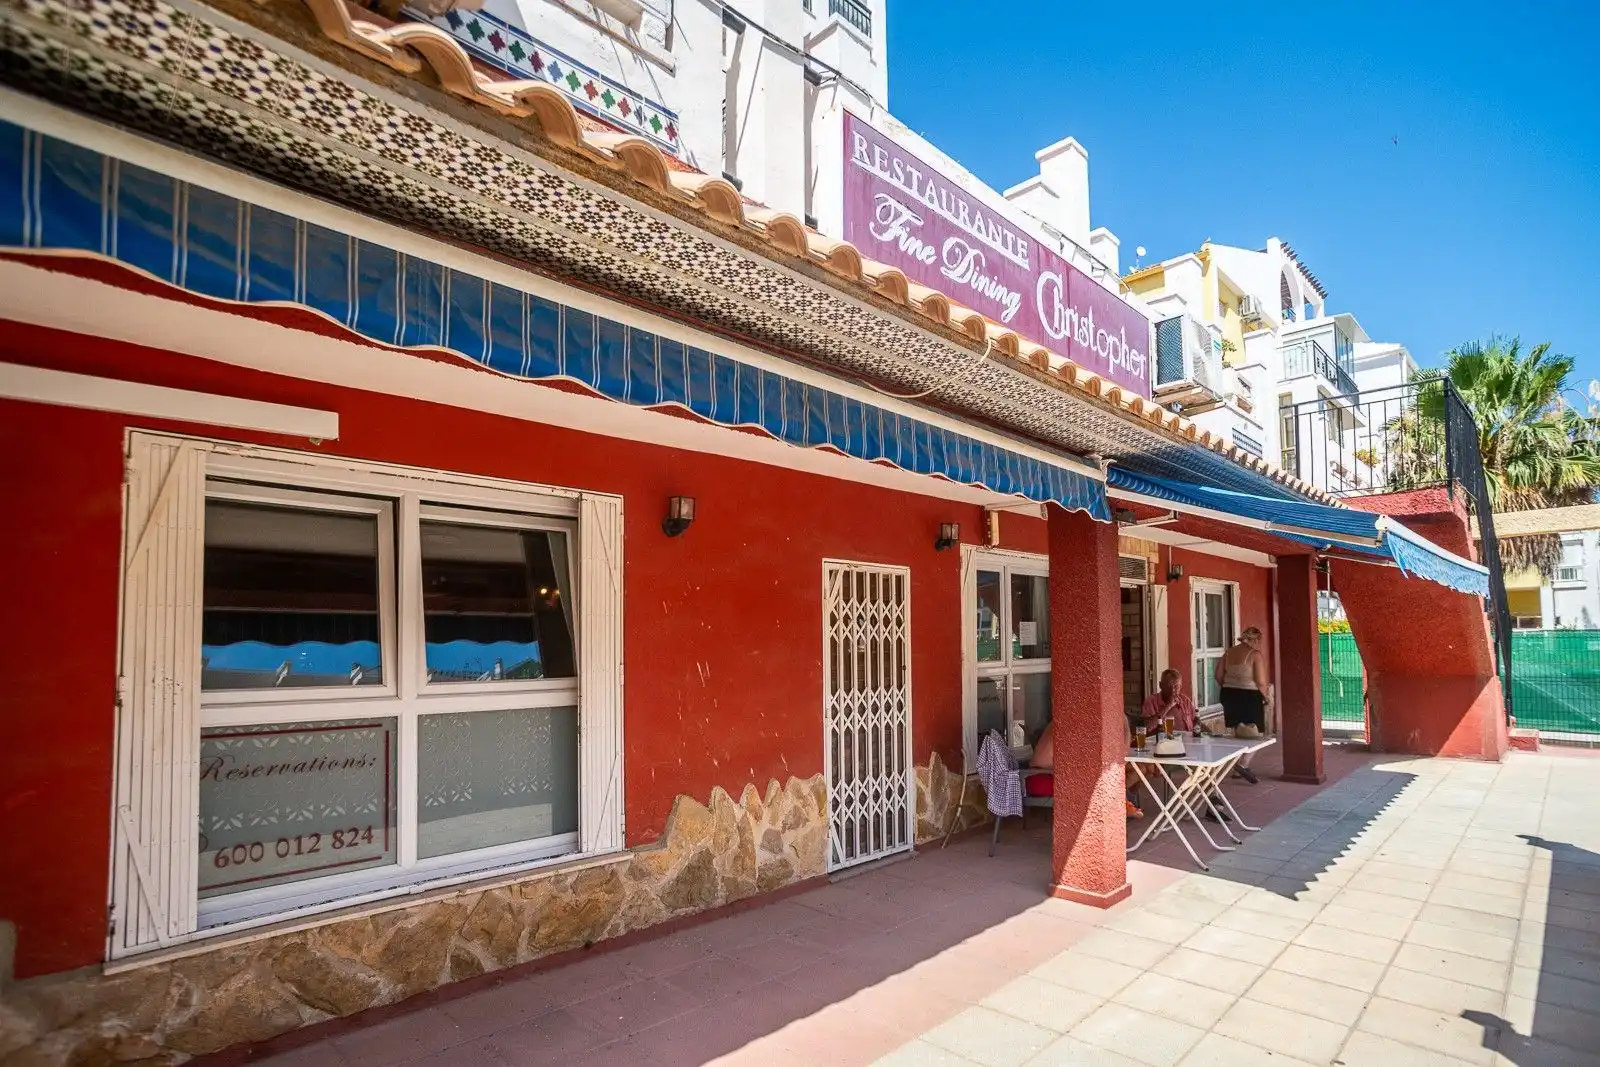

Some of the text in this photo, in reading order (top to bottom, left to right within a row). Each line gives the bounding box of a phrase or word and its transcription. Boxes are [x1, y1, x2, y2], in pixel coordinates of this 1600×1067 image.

[852, 131, 1029, 262] RESTAURANTE
[869, 193, 1021, 323] Fine Dining
[1037, 271, 1146, 380] Christopher
[200, 753, 377, 783] Reservations:
[214, 825, 374, 868] 600 012 824
